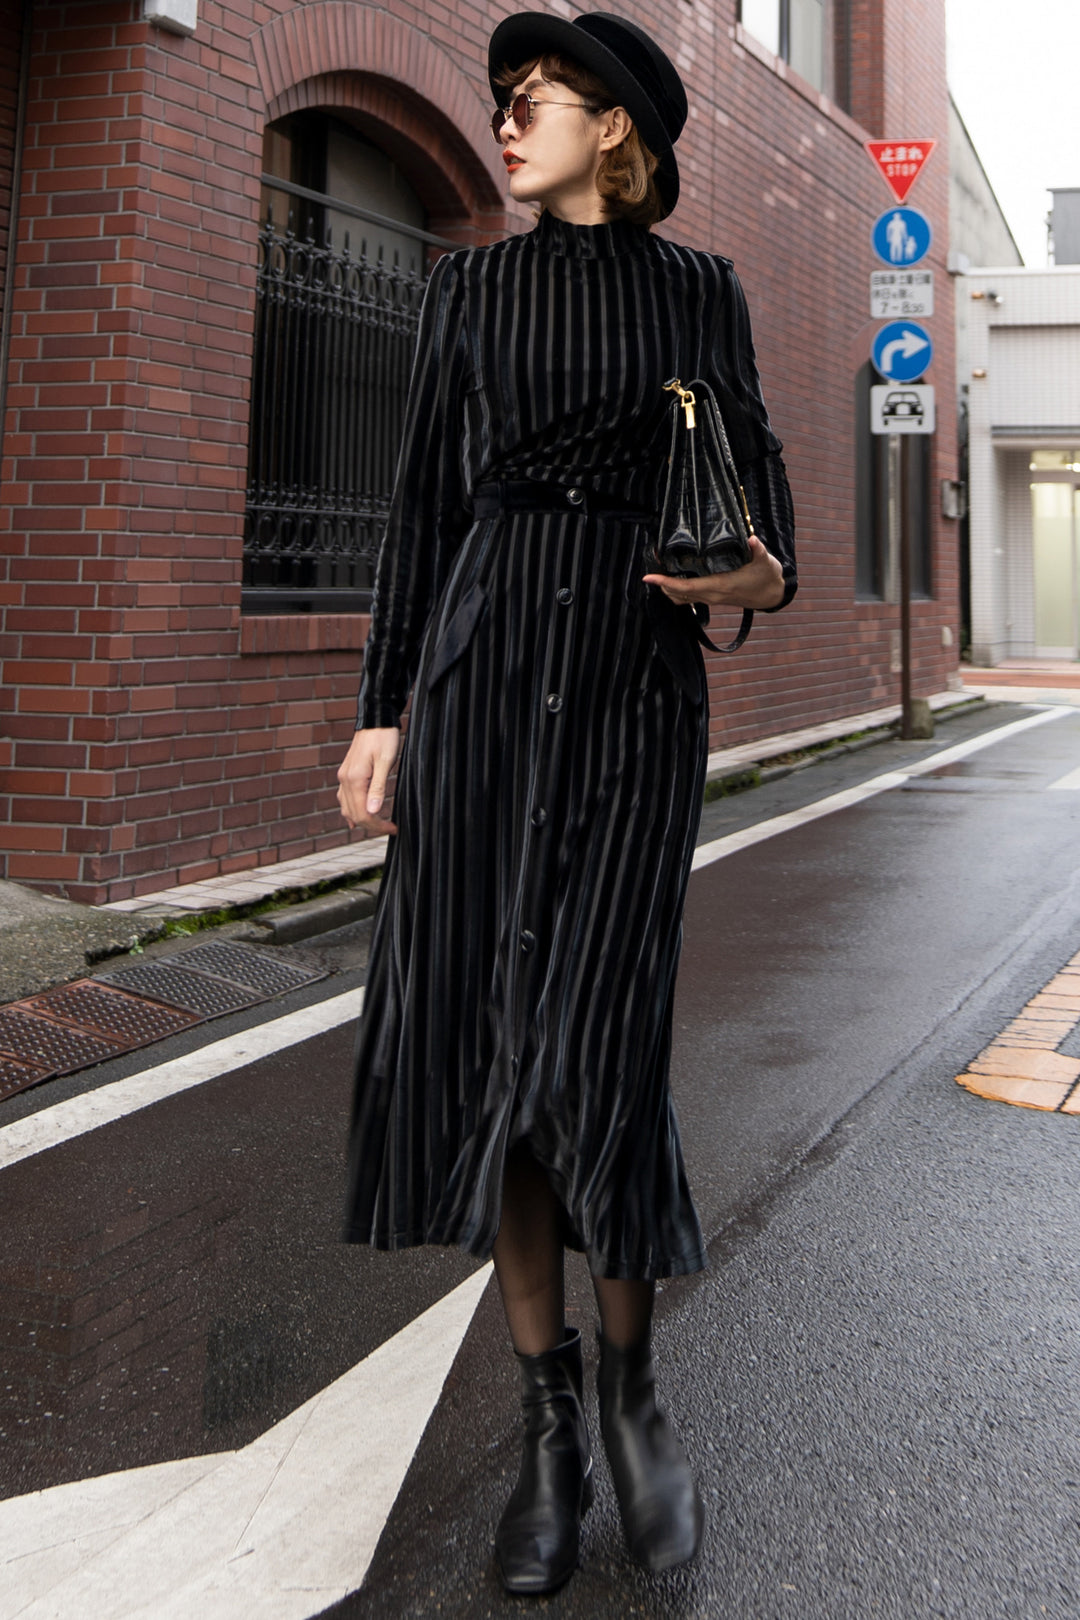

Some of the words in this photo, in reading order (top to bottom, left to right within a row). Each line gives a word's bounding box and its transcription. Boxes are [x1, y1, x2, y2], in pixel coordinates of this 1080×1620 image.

[880, 146, 923, 162] 止まれ
[887, 163, 918, 177] STOP
